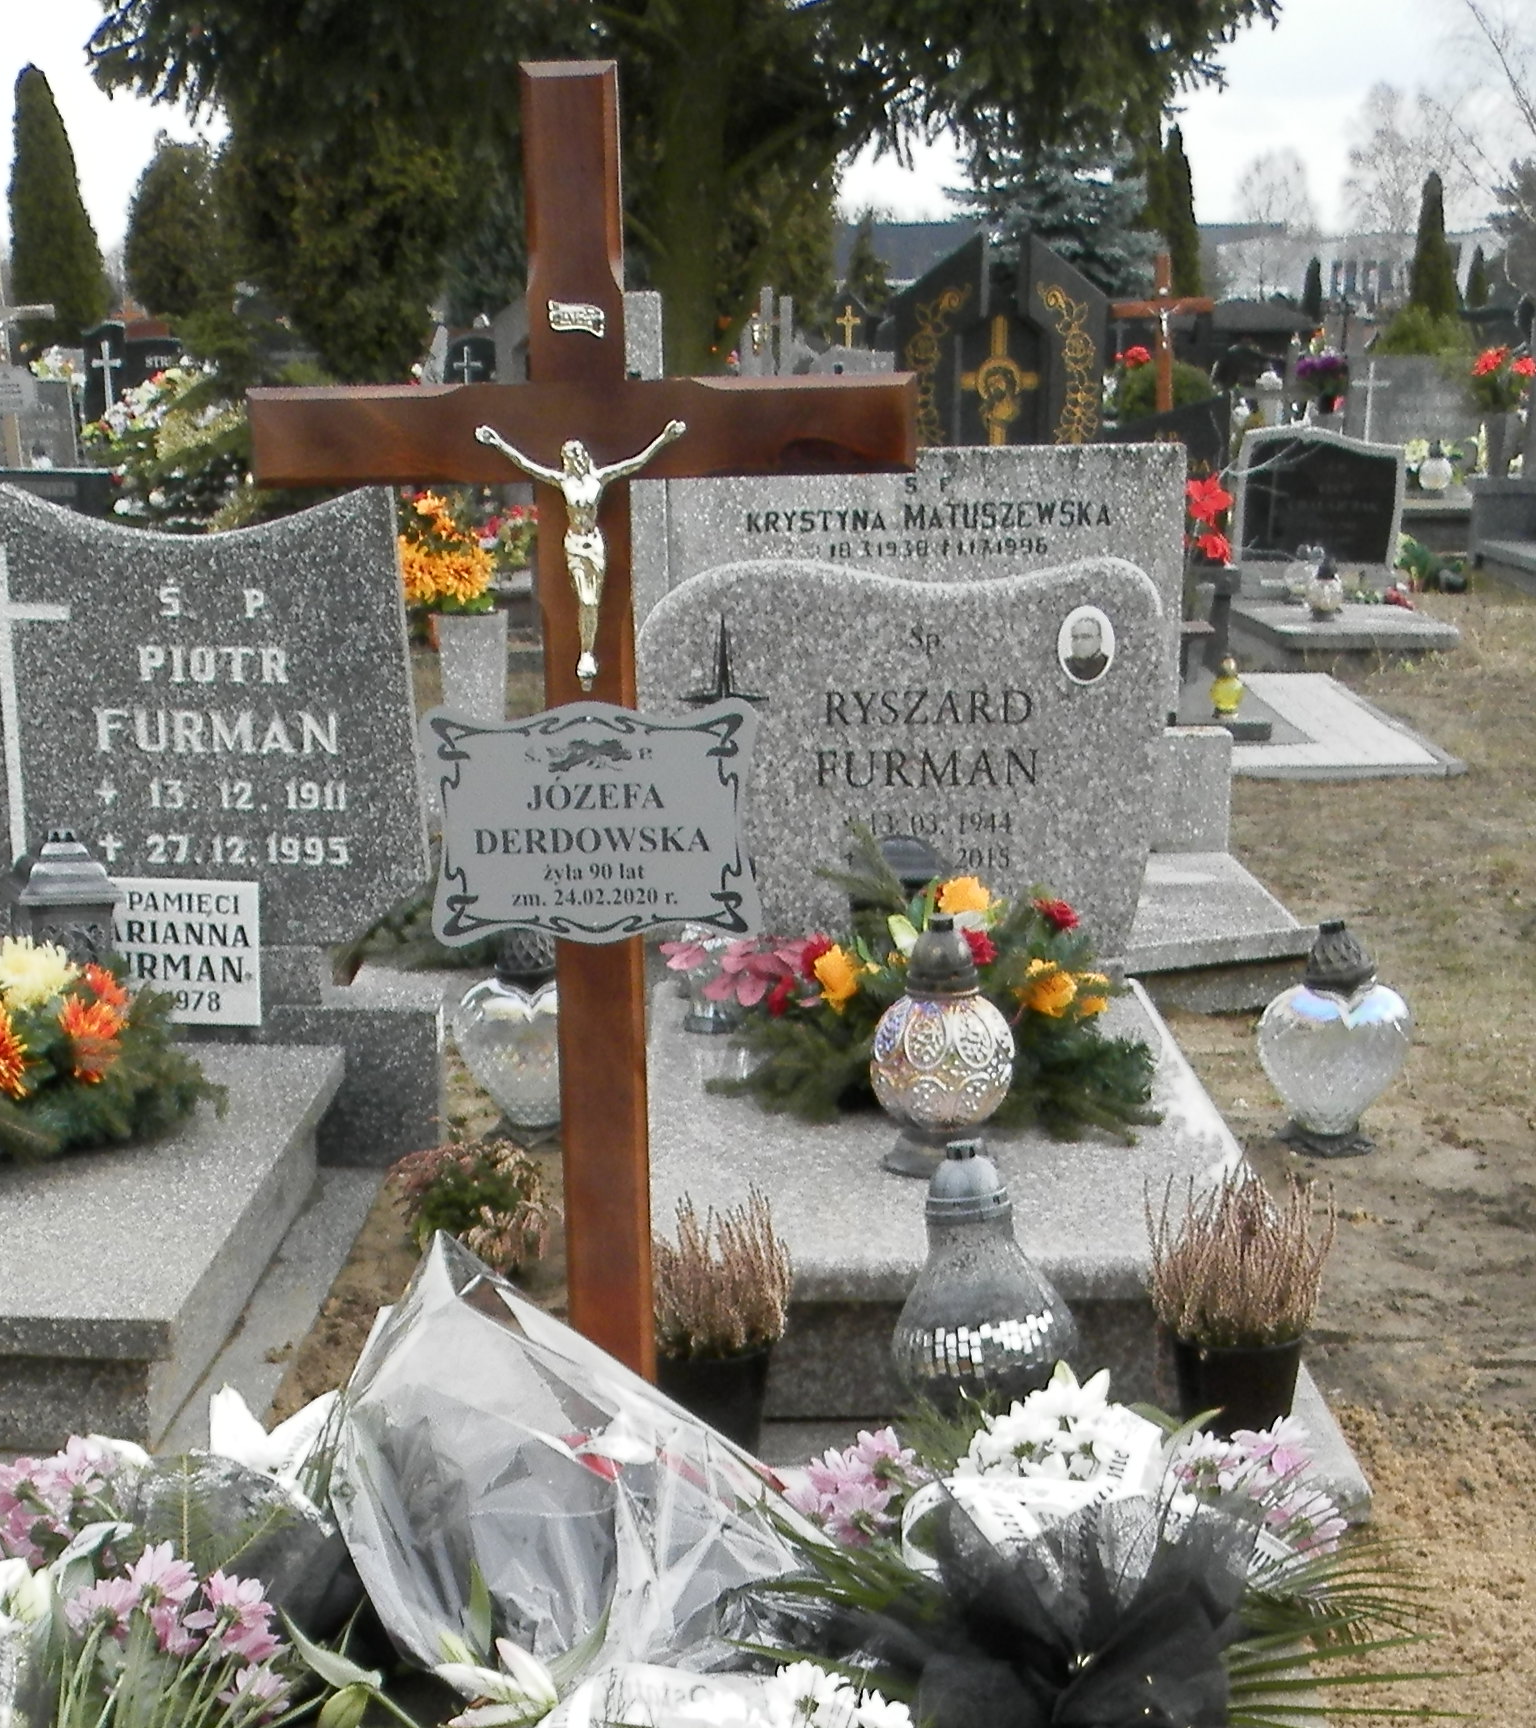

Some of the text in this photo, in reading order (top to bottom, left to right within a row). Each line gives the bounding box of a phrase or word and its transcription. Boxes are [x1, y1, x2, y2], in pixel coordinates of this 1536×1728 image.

[746, 500, 1112, 534] KRYSTYNA MATUSZEWSKA
[137, 645, 290, 684] PIOTR
[824, 688, 1034, 727] RYSZARD
[95, 707, 340, 756] FURMAN
[815, 748, 1039, 787] FURMAN
[284, 777, 348, 811] 1911
[527, 776, 665, 811] JÓZEFA
[474, 825, 711, 855] DERDOWSKA
[543, 862, 645, 885] żyła 90 lat
[127, 890, 241, 918] PAMIĘCI
[512, 886, 679, 907] zm. 24.02.2020 r.
[170, 990, 221, 1013] 978
